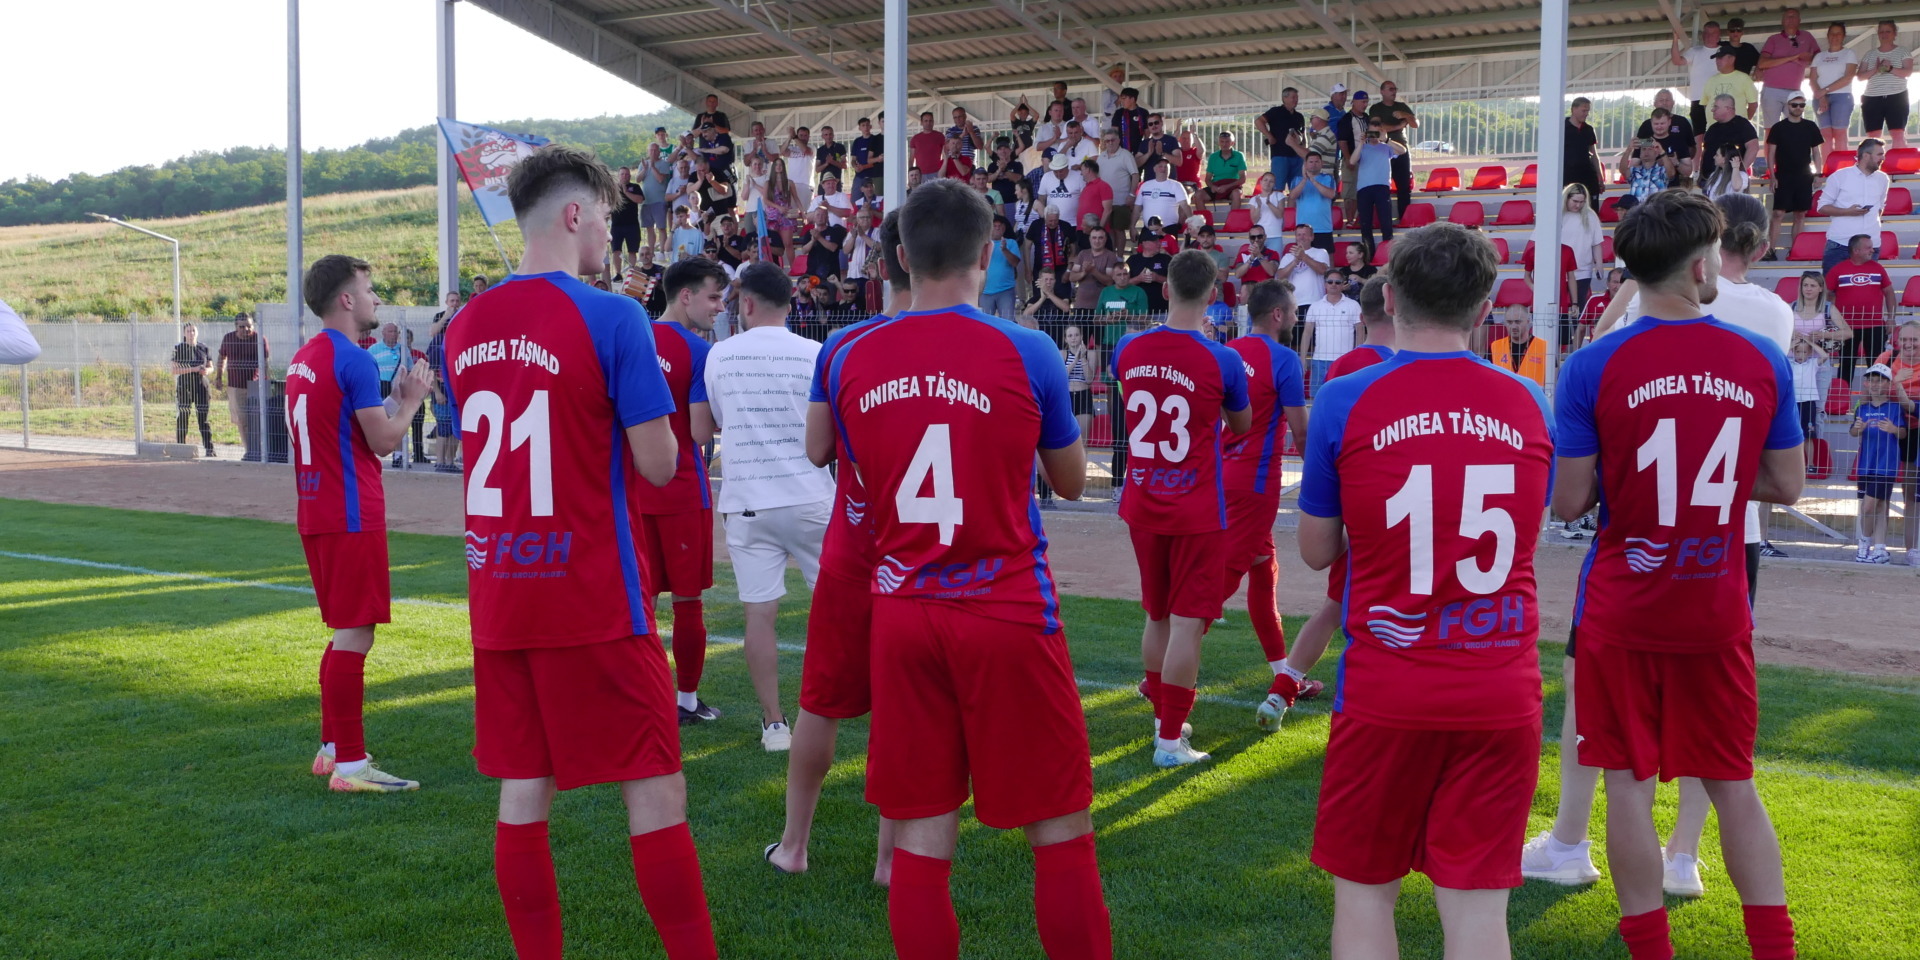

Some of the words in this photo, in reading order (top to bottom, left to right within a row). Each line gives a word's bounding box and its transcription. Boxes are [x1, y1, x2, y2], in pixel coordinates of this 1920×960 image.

[455, 339, 506, 376] UNIREA
[735, 370, 744, 378] the
[772, 354, 784, 363] just
[1125, 364, 1158, 381] UNIREA
[859, 375, 921, 414] UNIREA
[1627, 374, 1688, 409] UNIREA
[735, 439, 764, 447] something
[1126, 389, 1191, 464] 23
[1373, 412, 1445, 452] UNIREA
[461, 389, 554, 518] 21
[895, 423, 963, 547] 4
[1150, 467, 1198, 488] FGH
[1637, 417, 1742, 528] 14
[1385, 463, 1517, 596] 15
[494, 531, 573, 565] FGH
[914, 558, 1003, 589] FGH
[935, 591, 962, 599] GROUP
[1438, 595, 1524, 640] FGH
[1464, 640, 1493, 649] GROUP
